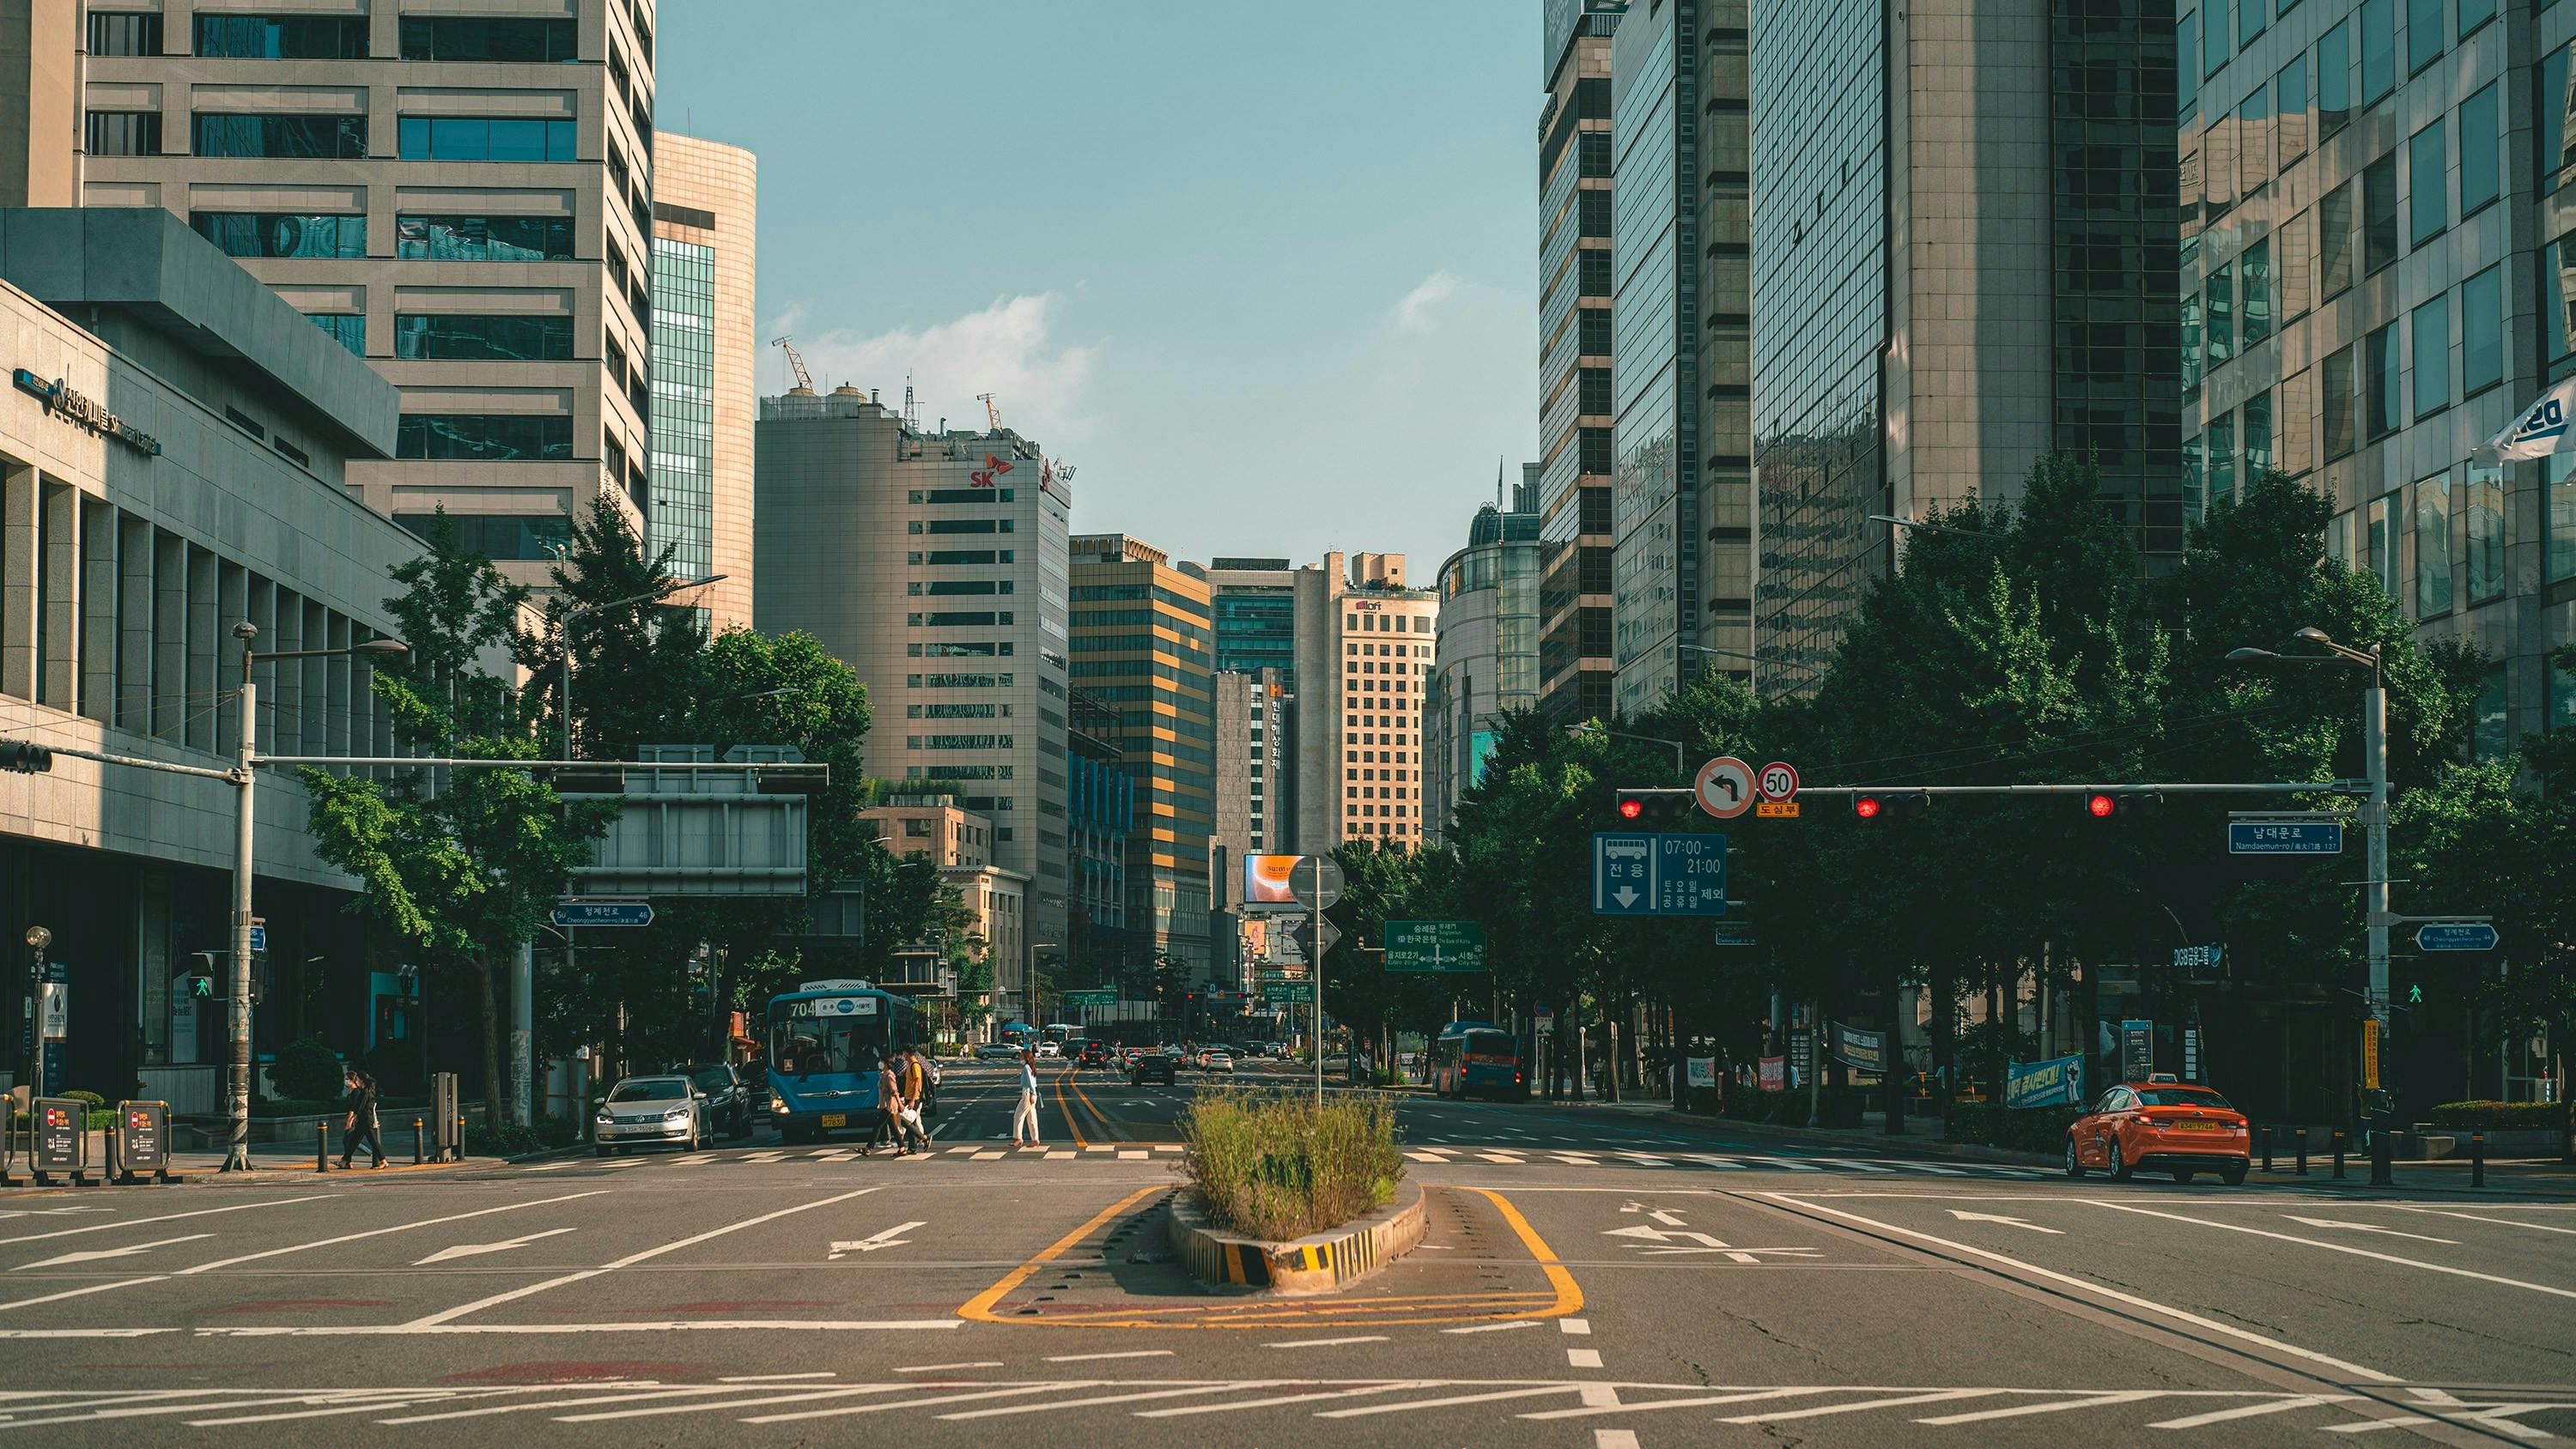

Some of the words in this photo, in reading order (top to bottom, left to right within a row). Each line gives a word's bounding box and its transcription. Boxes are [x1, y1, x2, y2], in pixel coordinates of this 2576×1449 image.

[970, 471, 995, 488] SK
[1271, 700, 1280, 769] 현대해상화재
[1765, 773, 1789, 792] 50
[1760, 805, 1796, 815] 도심부
[2254, 827, 2302, 840] 남대문로
[1687, 858, 1721, 873] 21:00
[1700, 888, 1724, 900] 제외
[585, 906, 619, 916] 청계천로
[1406, 935, 1437, 943] 한국은행
[1388, 951, 1419, 960] 을지로2가
[1459, 951, 1473, 961] 시청
[790, 1000, 816, 1016] 704
